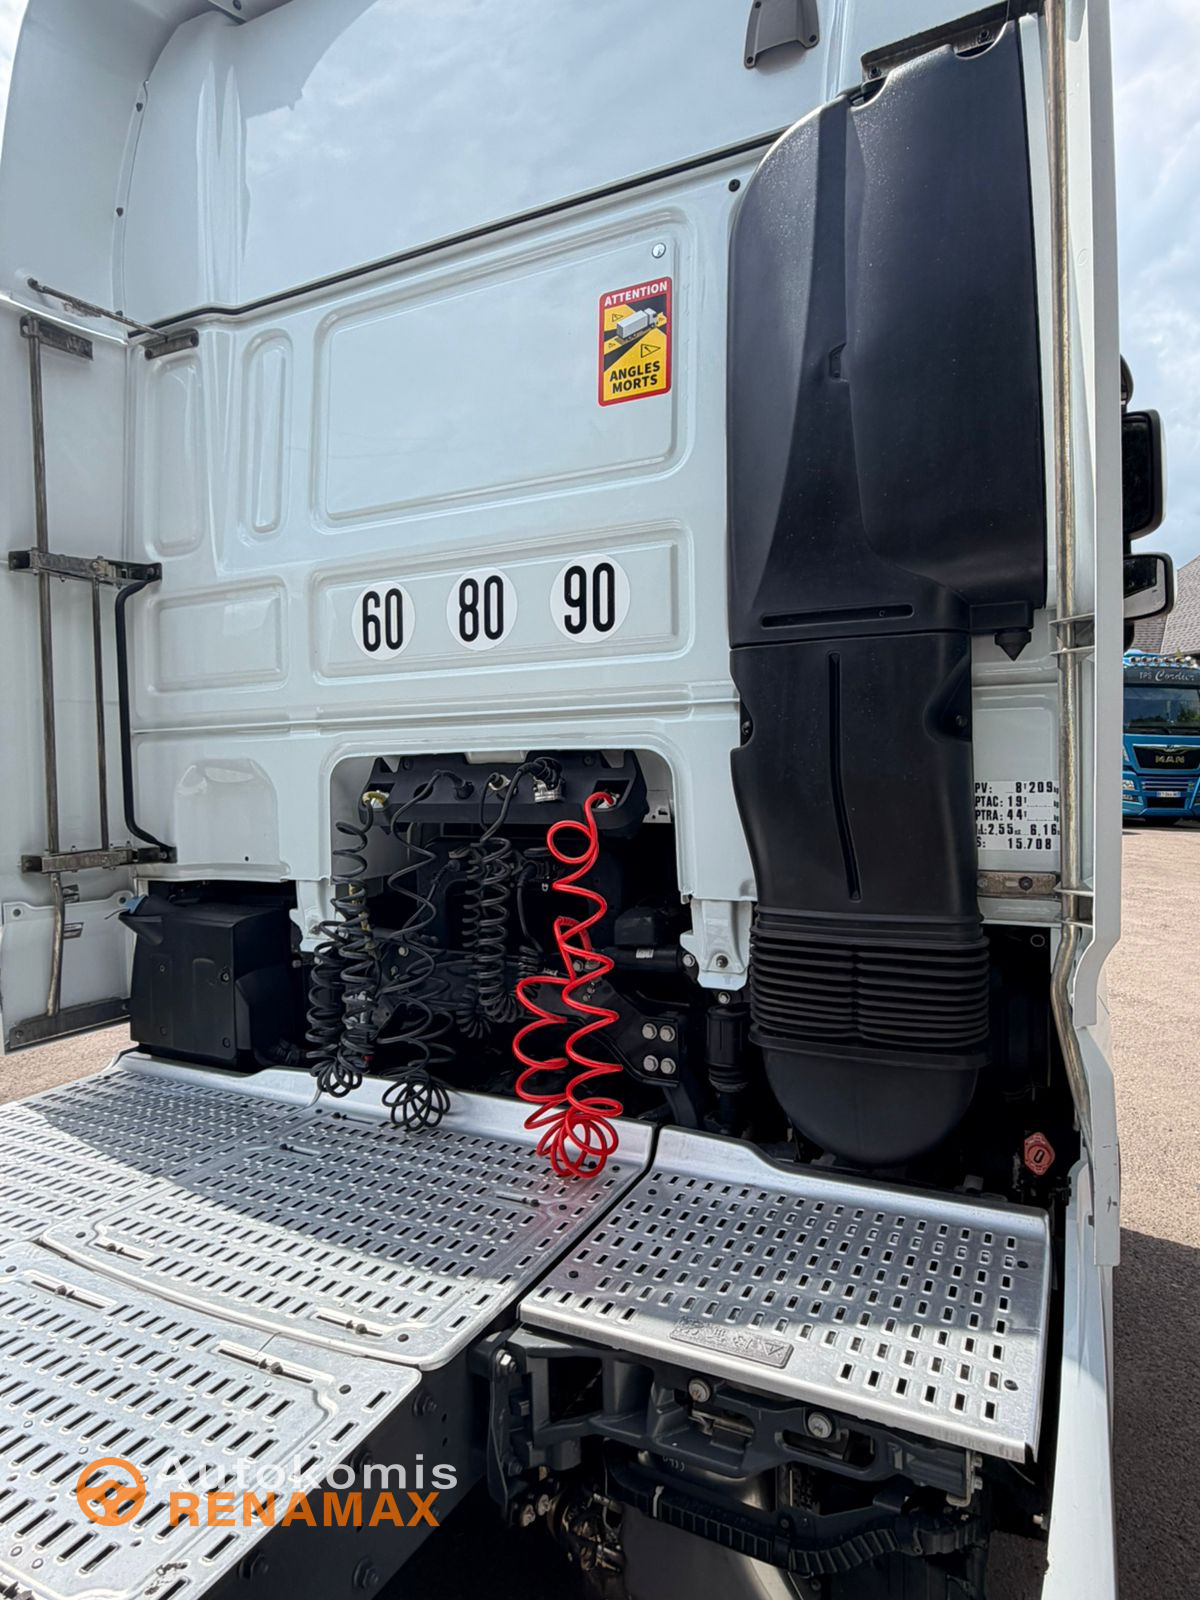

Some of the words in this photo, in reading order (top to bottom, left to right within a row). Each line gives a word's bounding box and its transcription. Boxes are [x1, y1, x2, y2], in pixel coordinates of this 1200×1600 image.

[604, 281, 668, 307] ATTENTION
[610, 361, 660, 382] ANGLES
[612, 374, 658, 394] MORTS
[564, 562, 615, 634] 90
[459, 575, 504, 642] 80
[362, 588, 403, 652] 60
[1155, 755, 1185, 763] MAN
[975, 782, 992, 794] PV:
[975, 796, 1003, 807] PTAC:
[975, 809, 1003, 821] PTRA:
